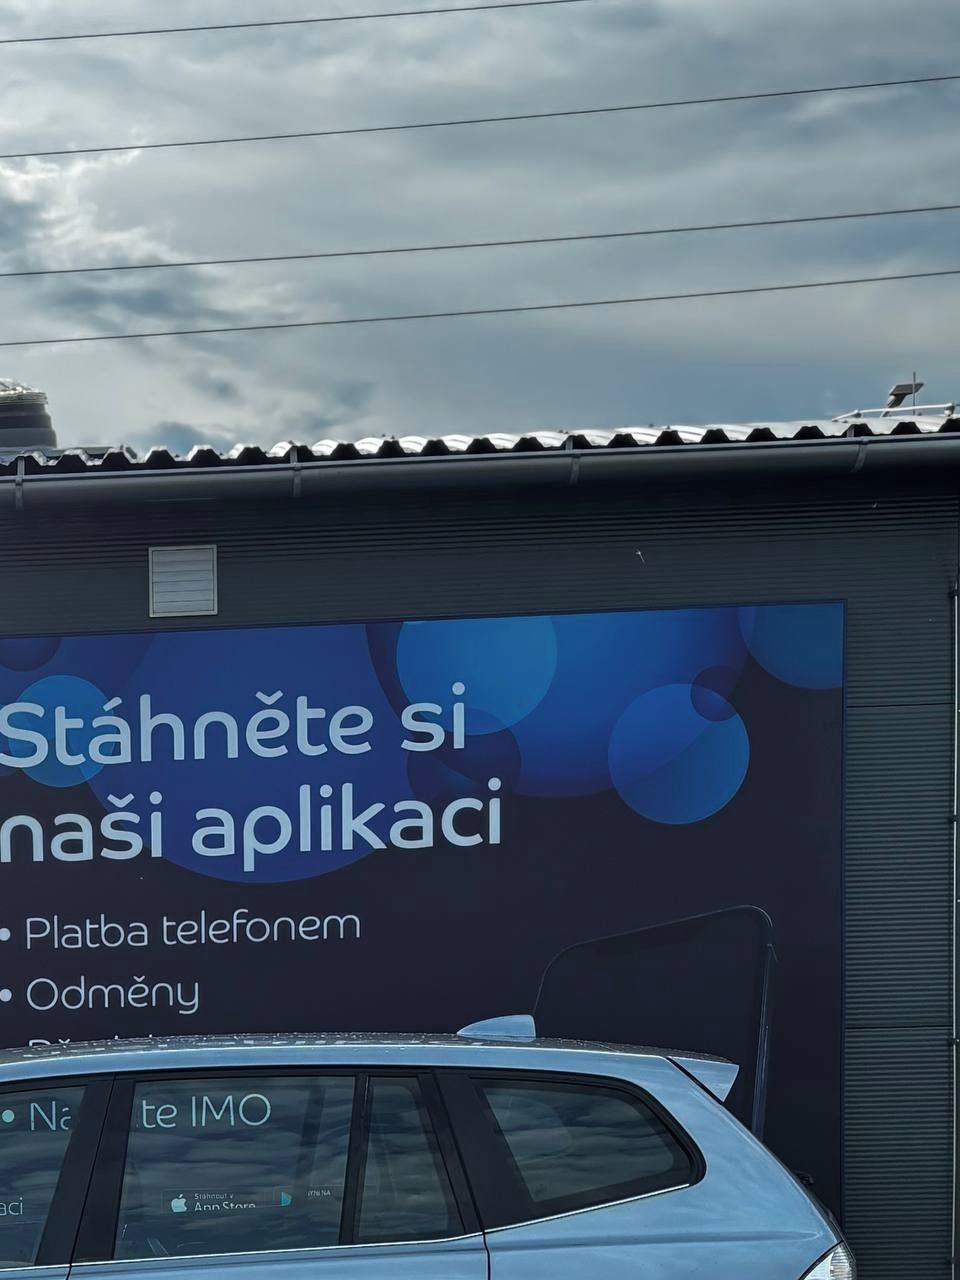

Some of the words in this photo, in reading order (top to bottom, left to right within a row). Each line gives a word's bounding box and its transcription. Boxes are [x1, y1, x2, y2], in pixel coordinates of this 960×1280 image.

[400, 682, 465, 752] si
[0, 791, 163, 863] naši
[191, 777, 502, 872] aplikaci
[26, 913, 148, 949] Platba
[162, 908, 361, 945] telefonem
[26, 975, 199, 1015] Odměny
[192, 1093, 271, 1127] IMO
